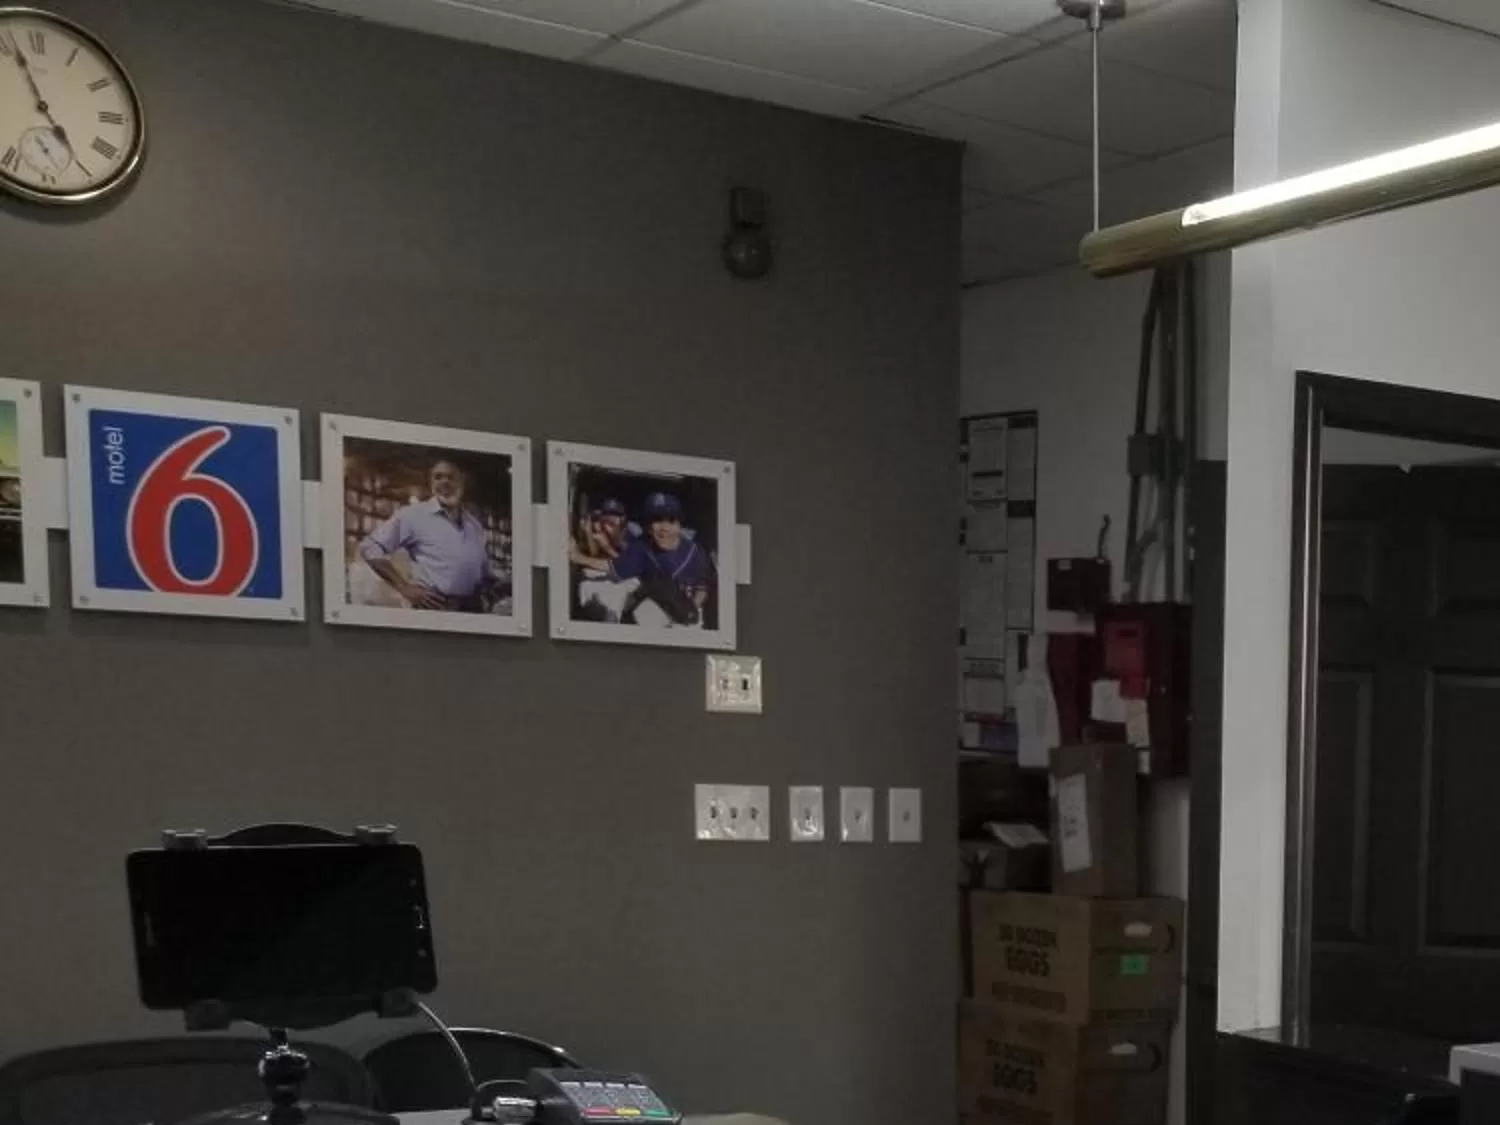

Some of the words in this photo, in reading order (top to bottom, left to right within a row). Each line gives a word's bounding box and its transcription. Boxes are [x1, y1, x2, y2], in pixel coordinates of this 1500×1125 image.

[103, 426, 125, 485] motel
[126, 425, 259, 597] 6
[1006, 945, 1051, 977] EGGS
